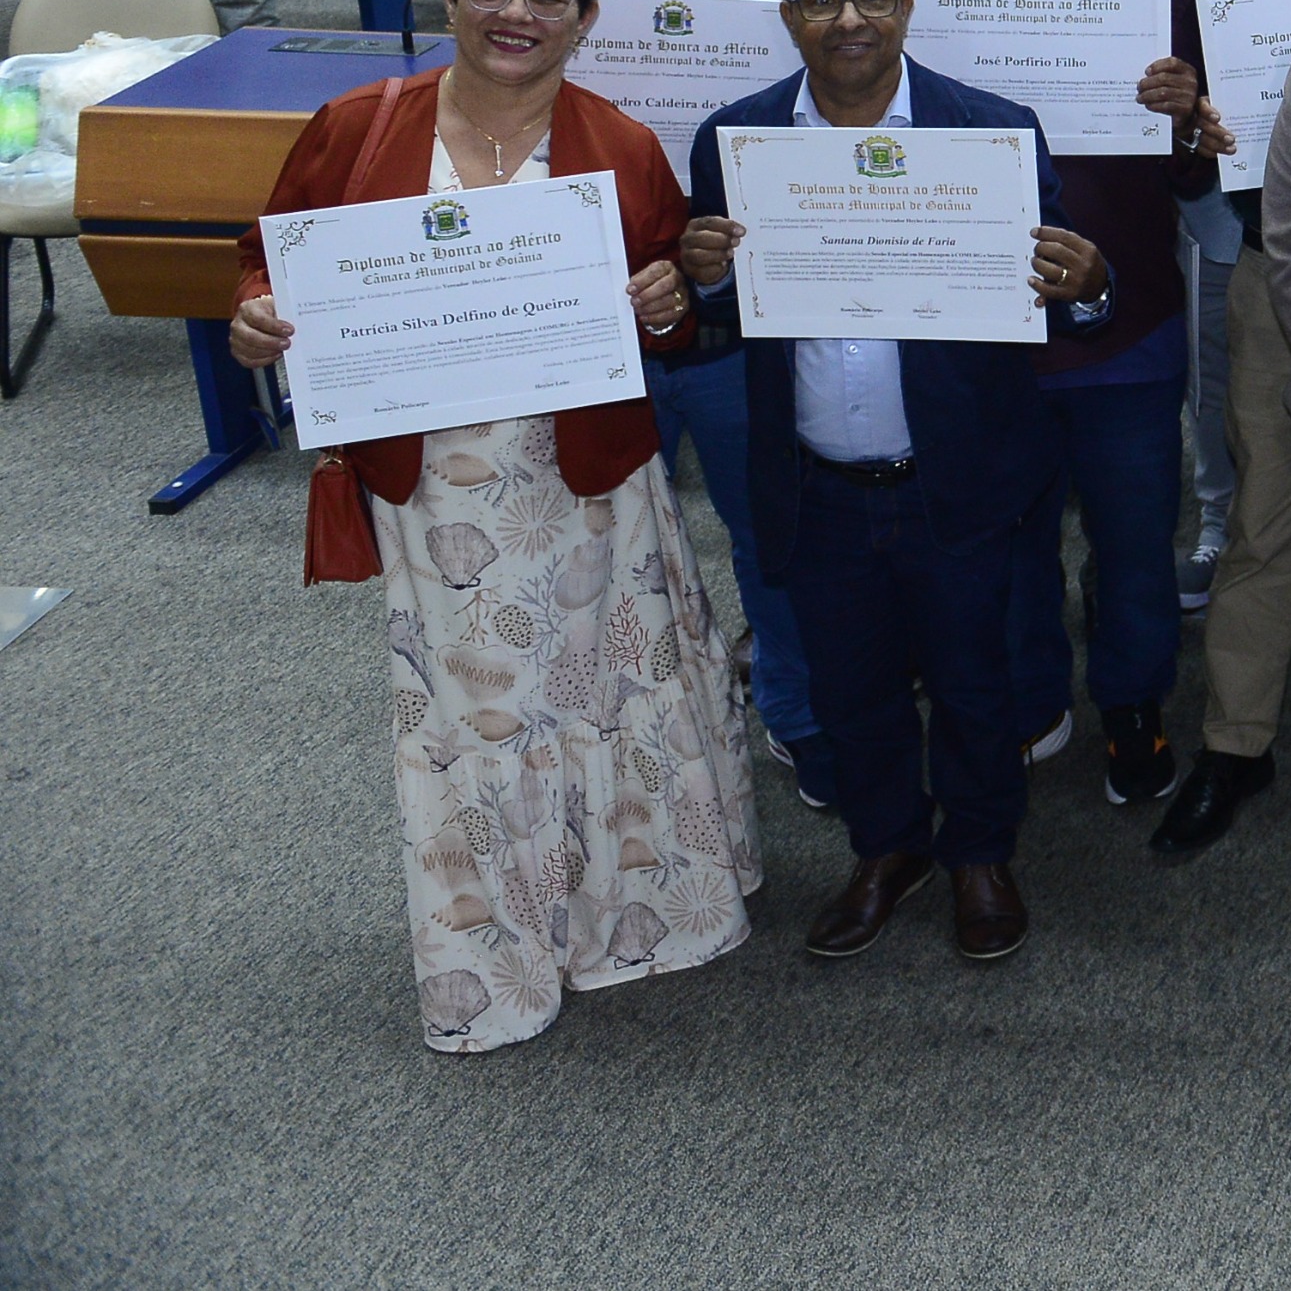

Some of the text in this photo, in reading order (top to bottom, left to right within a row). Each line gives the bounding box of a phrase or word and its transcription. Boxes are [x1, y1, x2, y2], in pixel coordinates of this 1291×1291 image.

[1058, 1, 1073, 10] ao
[974, 55, 1001, 66] José
[1055, 57, 1087, 68] Filho
[644, 97, 717, 110] Caldeira de
[787, 183, 979, 197] Diploma de Honra ao Mérito
[798, 198, 972, 212] Câmara Municipal de Goiânia
[820, 235, 864, 245] Santana
[911, 236, 925, 246] de
[927, 236, 956, 246] Faria
[336, 232, 562, 274] Diploma de Honra ao Mérito
[362, 253, 543, 286] Câmara Municipal de Goiânia
[340, 298, 580, 339] Patrícia Silva Delfino de Queiroz
